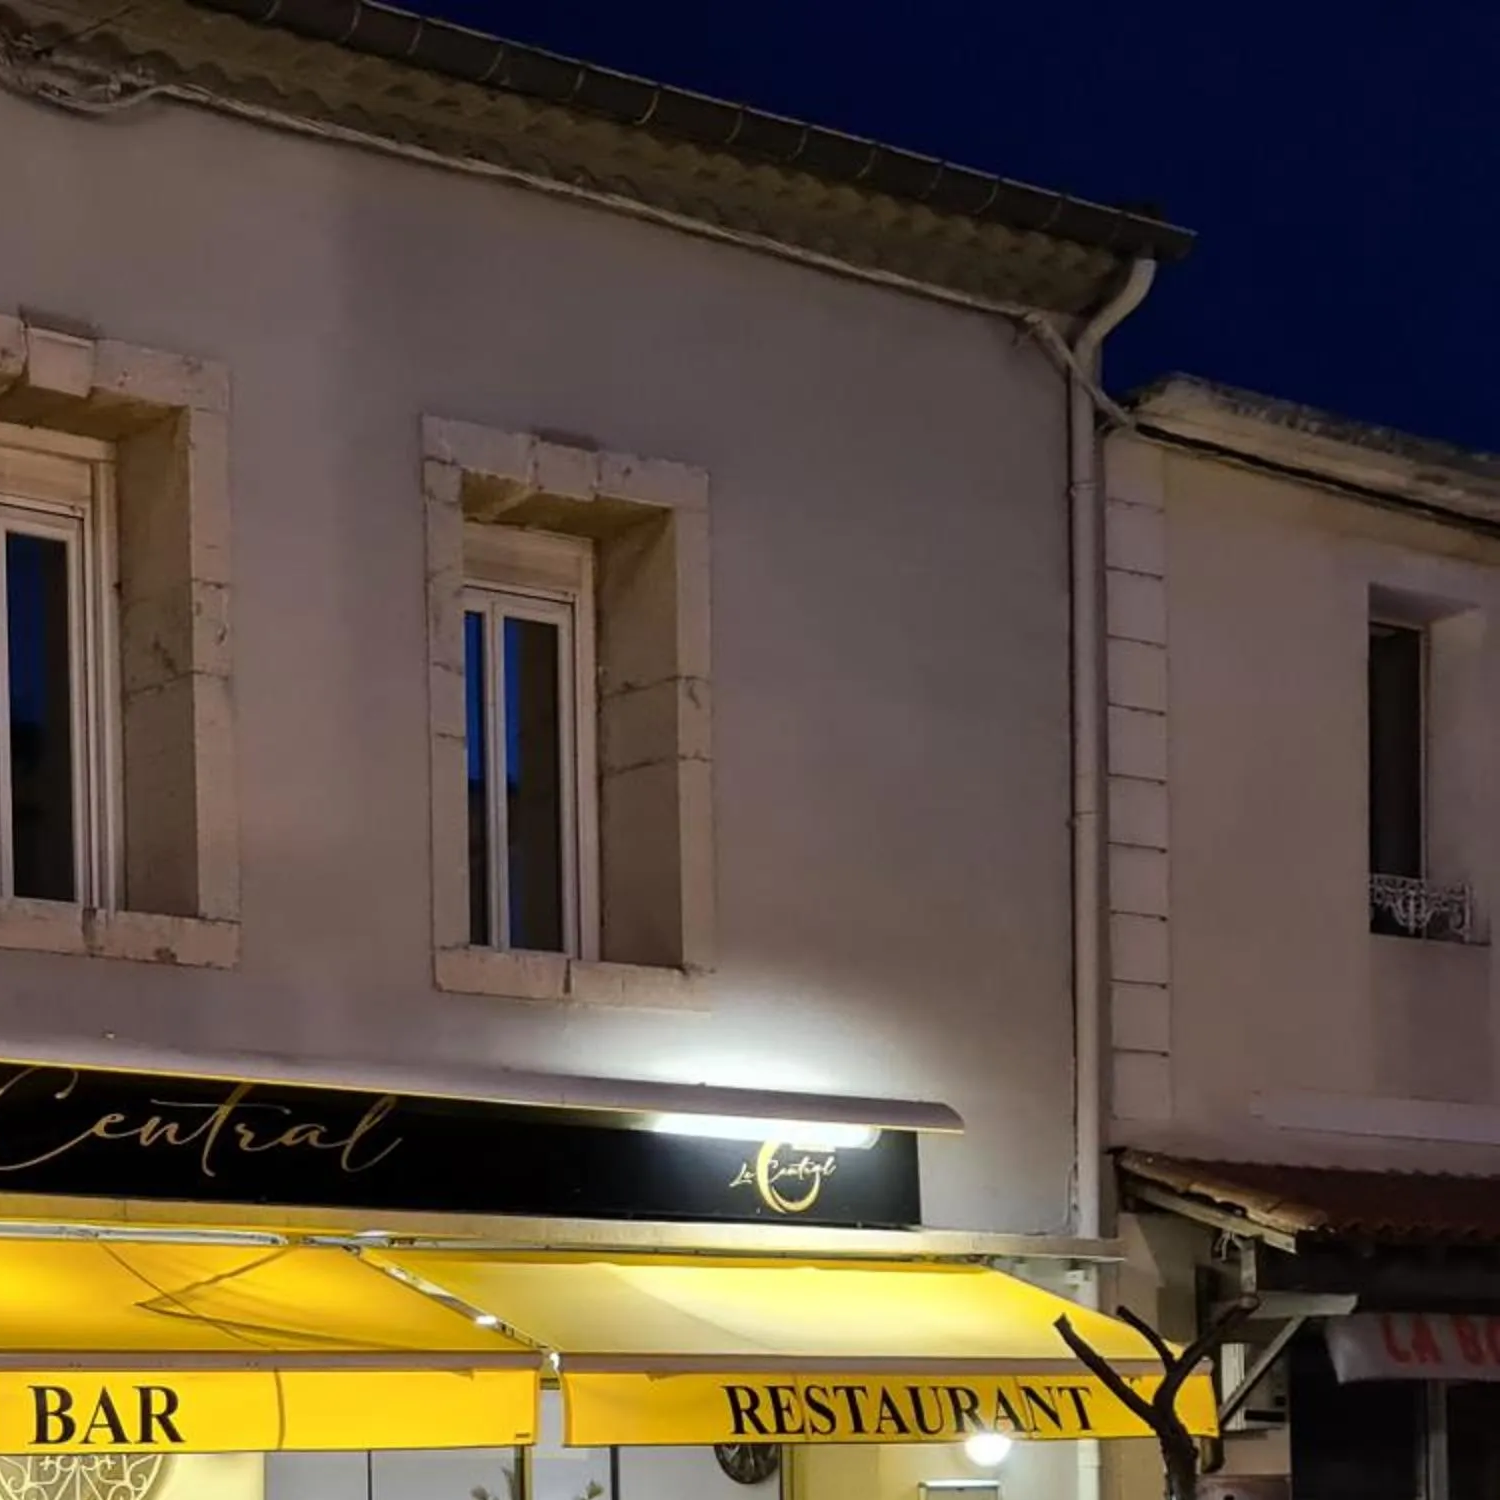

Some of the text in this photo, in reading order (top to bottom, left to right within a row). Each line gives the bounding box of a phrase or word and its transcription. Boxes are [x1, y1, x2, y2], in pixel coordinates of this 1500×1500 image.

[728, 1162, 756, 1188] Le
[27, 1385, 187, 1445] BAR
[720, 1385, 1093, 1436] RESTAURANT
